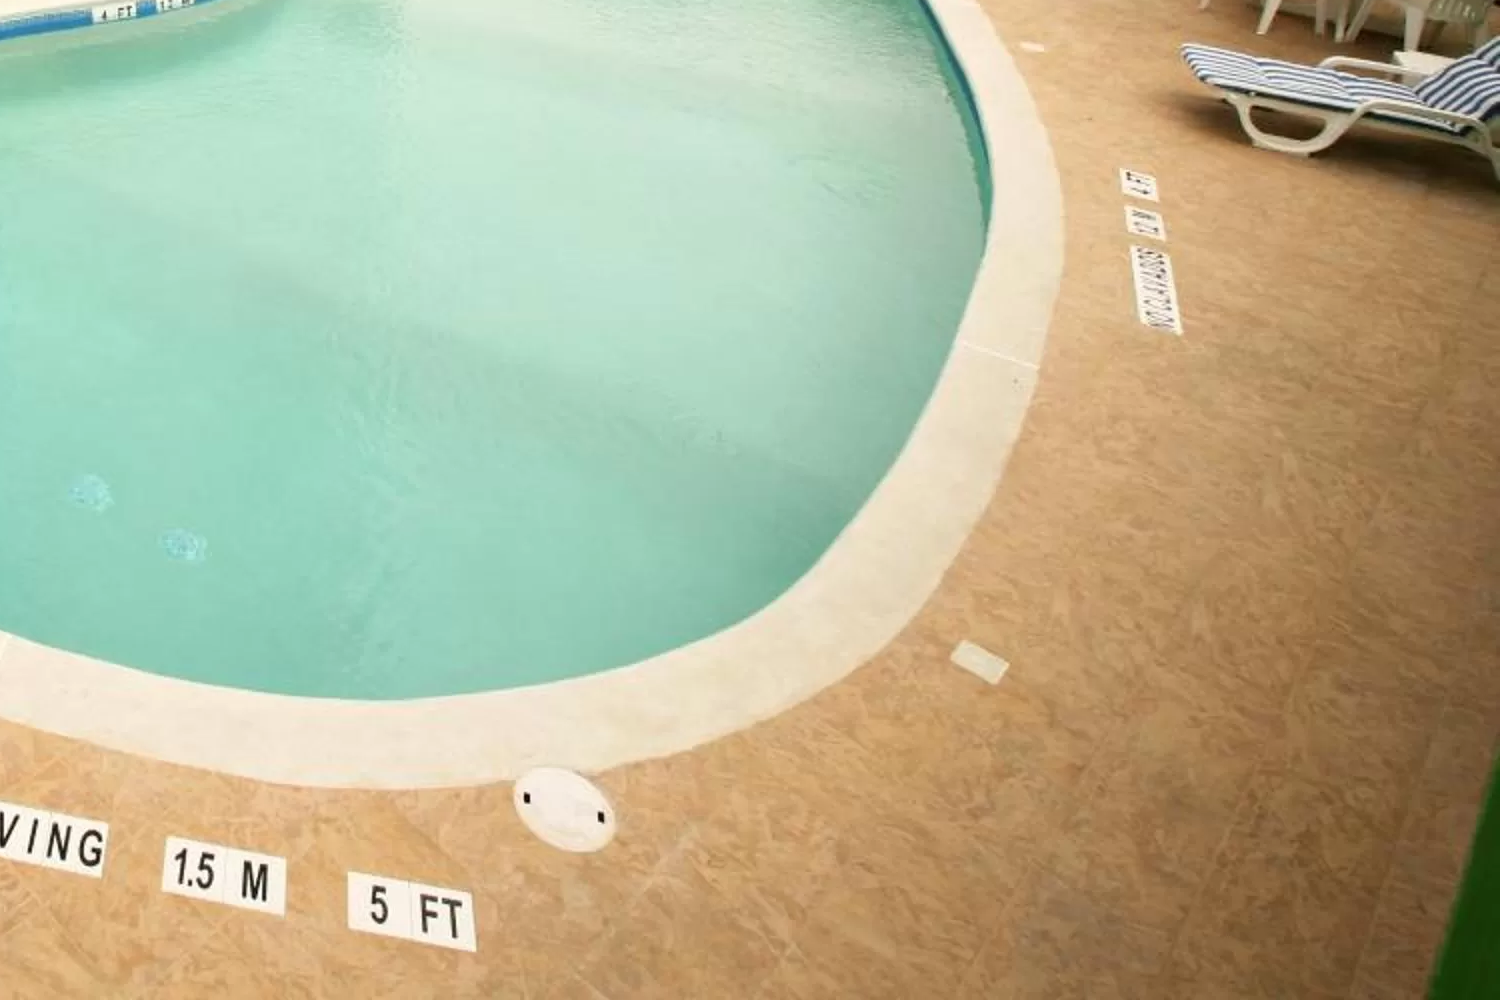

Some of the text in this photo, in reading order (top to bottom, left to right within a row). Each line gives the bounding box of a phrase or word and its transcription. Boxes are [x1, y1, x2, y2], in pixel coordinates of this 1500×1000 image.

[117, 5, 133, 17] FT
[174, 848, 269, 903] 1.5 M
[370, 884, 463, 939] 5 FT
